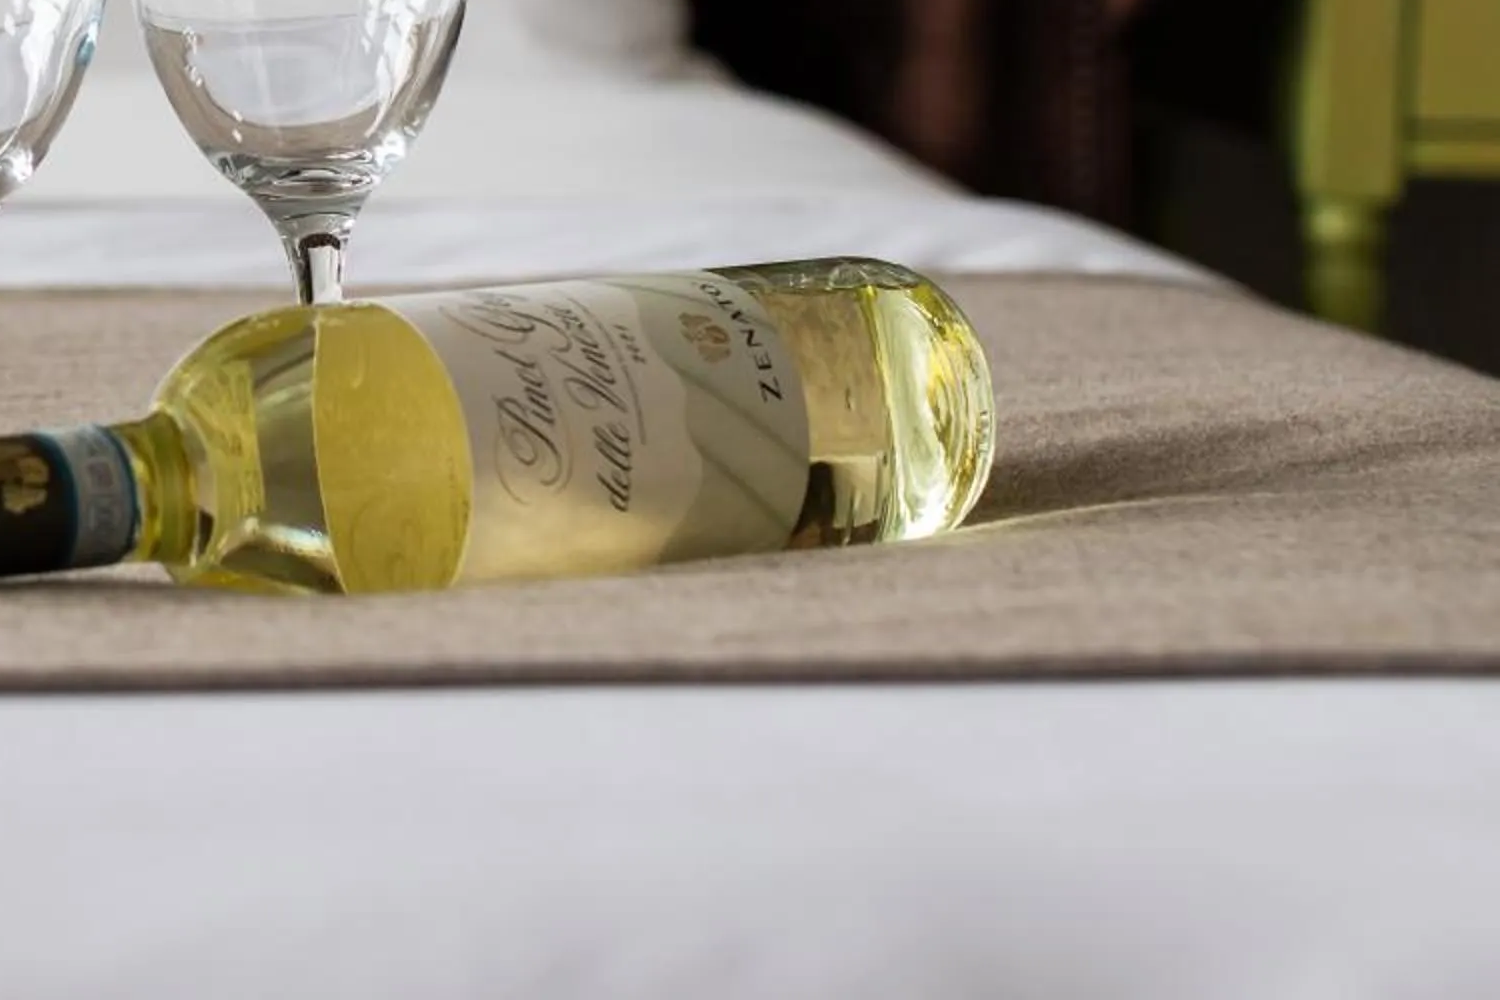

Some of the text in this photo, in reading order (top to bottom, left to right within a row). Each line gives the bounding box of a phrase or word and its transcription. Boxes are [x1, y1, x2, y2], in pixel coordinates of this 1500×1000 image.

[700, 282, 784, 403] ZENATO
[494, 349, 574, 505] Pinot
[592, 421, 633, 513] delle
